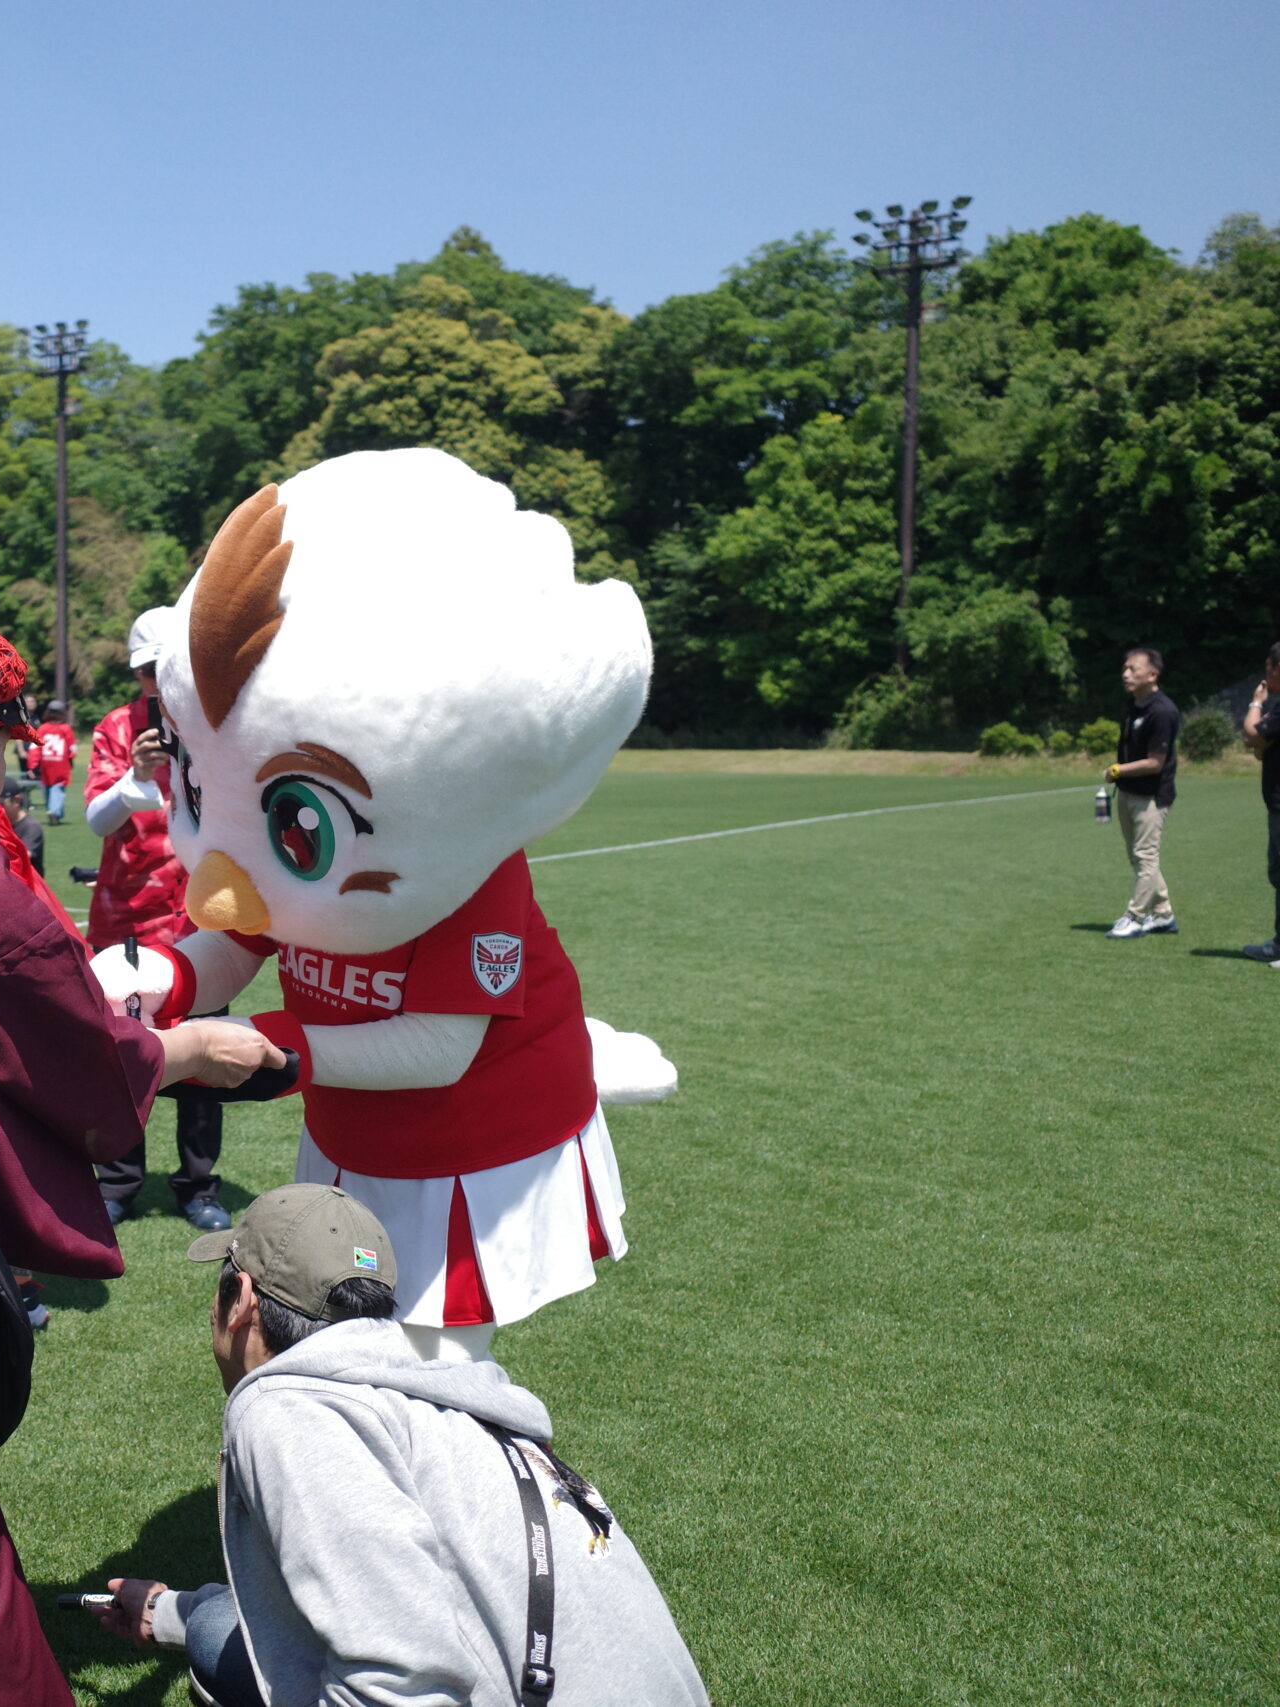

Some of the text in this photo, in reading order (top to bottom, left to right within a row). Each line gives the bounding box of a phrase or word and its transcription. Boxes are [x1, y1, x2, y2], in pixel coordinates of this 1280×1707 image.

[42, 733, 65, 756] 24
[278, 944, 407, 1010] EAGLES
[478, 962, 517, 974] EAGLES
[291, 981, 347, 1011] YOKOHAMA
